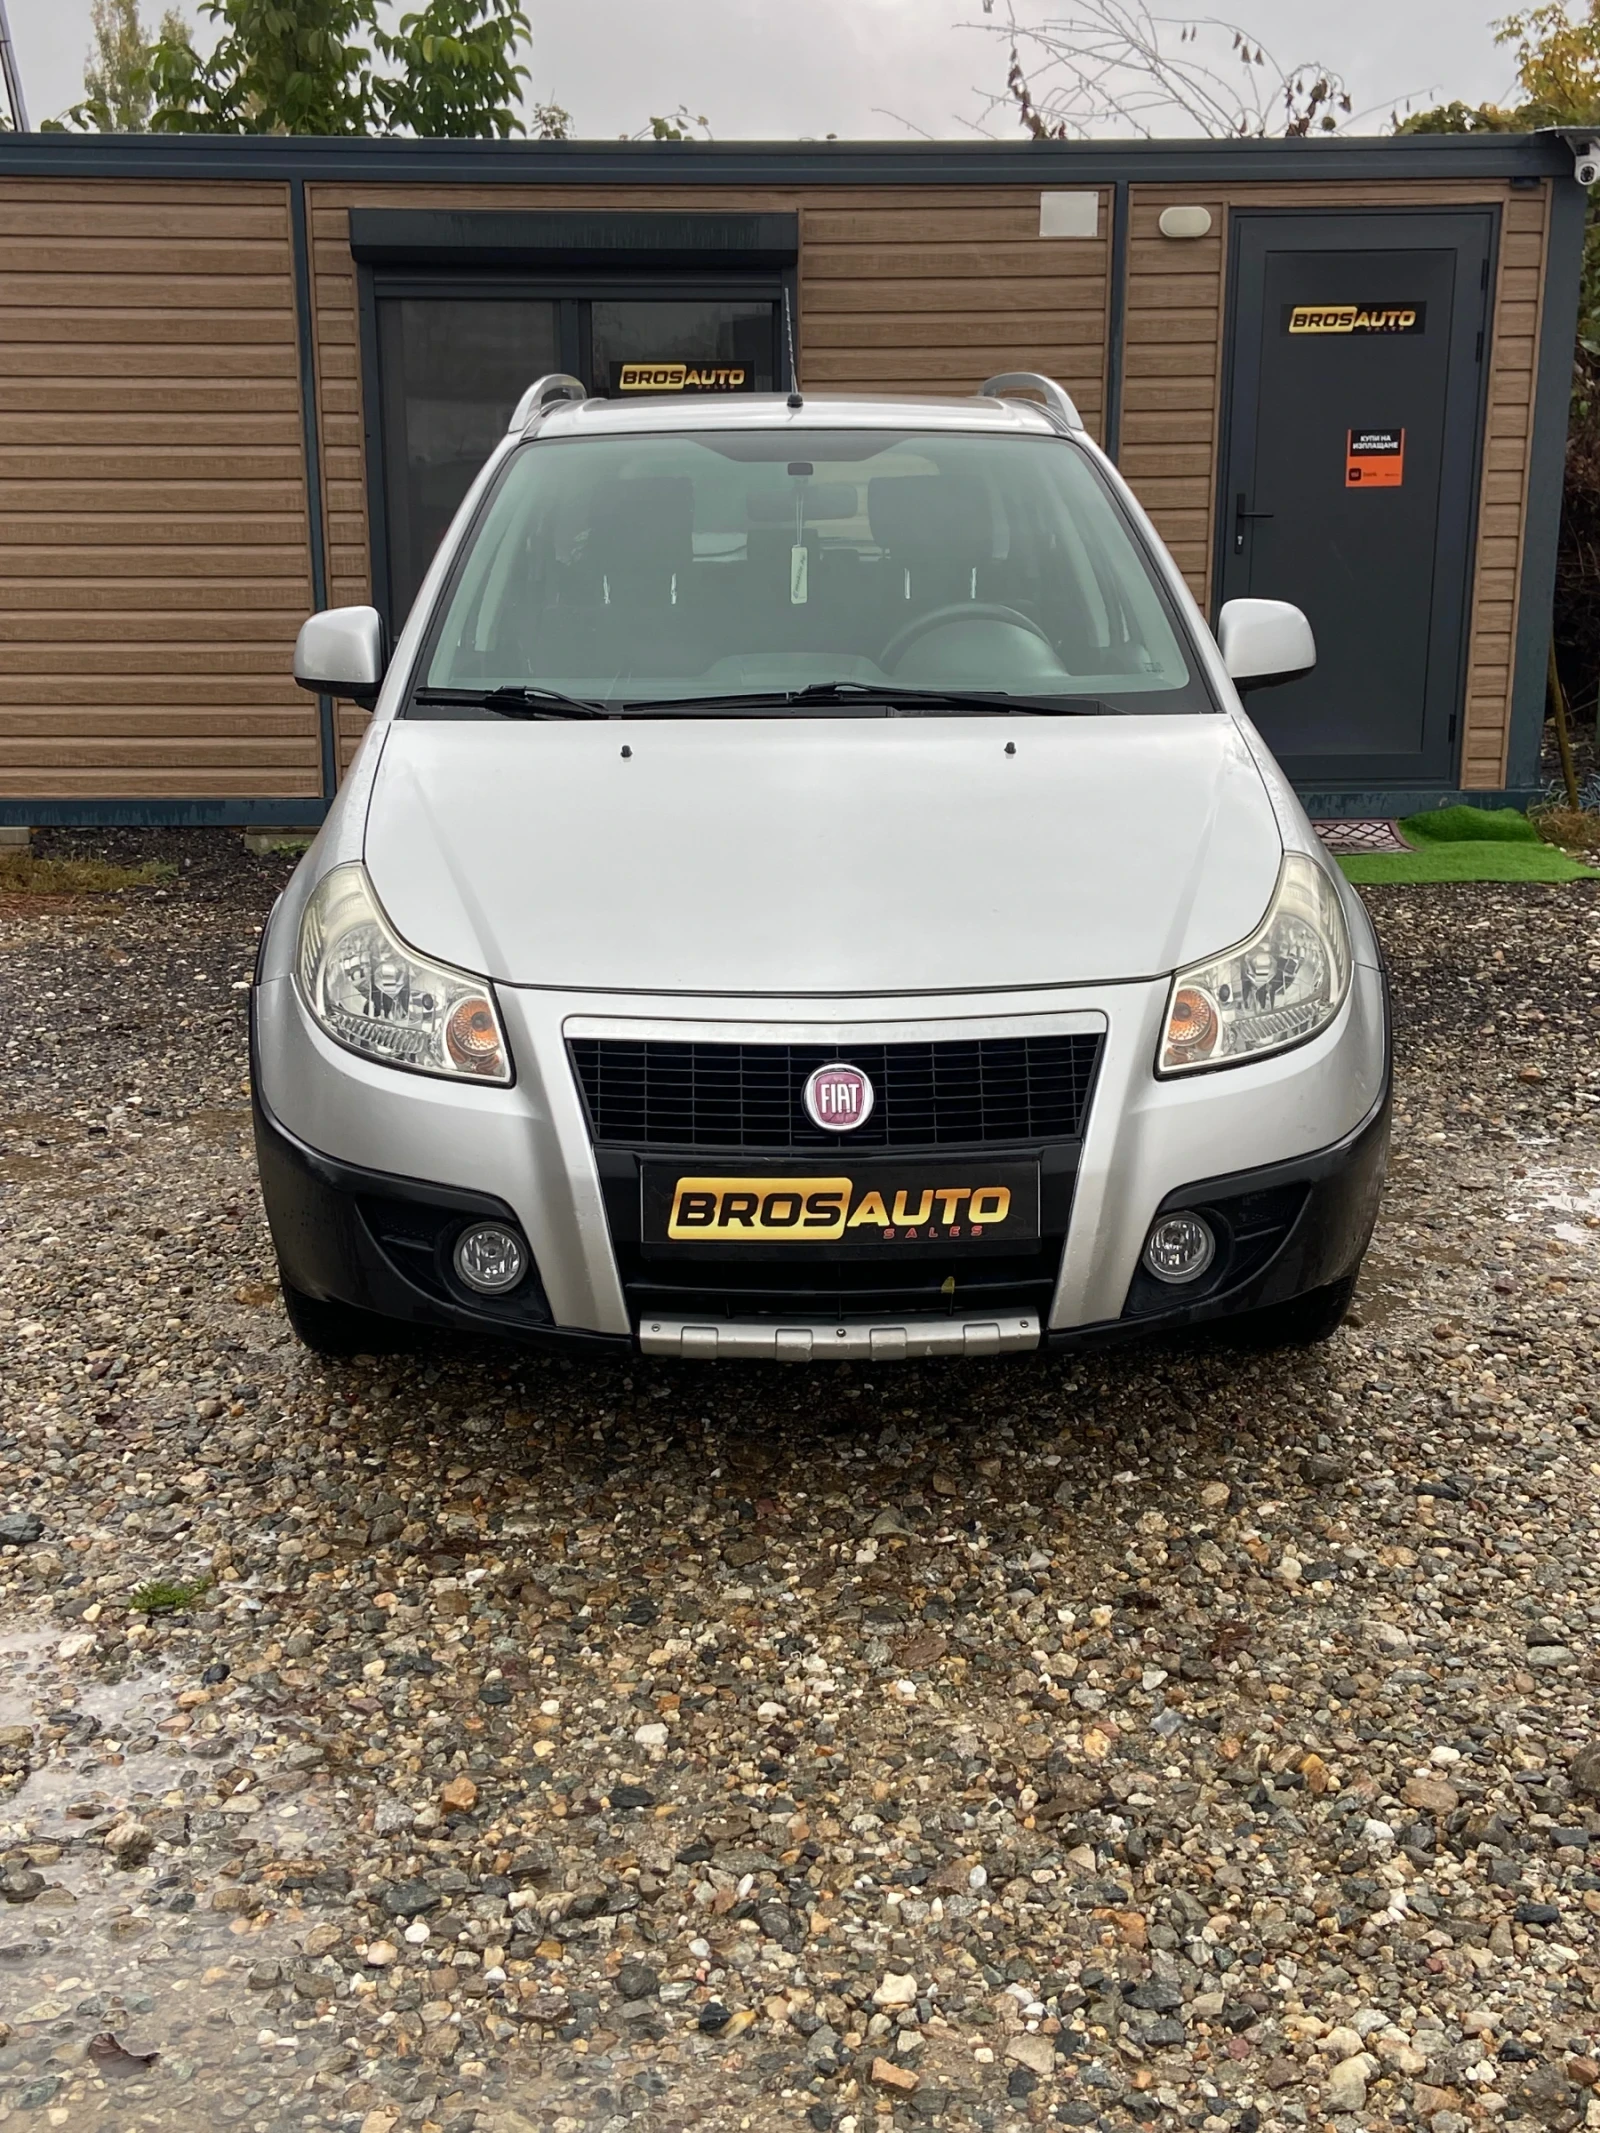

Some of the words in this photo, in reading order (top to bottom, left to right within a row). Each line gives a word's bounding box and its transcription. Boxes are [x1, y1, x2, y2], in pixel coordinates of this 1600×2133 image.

[1380, 434, 1392, 442] НА
[1352, 441, 1399, 450] ИЗПЛАЩАНЕ
[820, 1083, 860, 1114] FIAT
[882, 1225, 983, 1240] SALES
